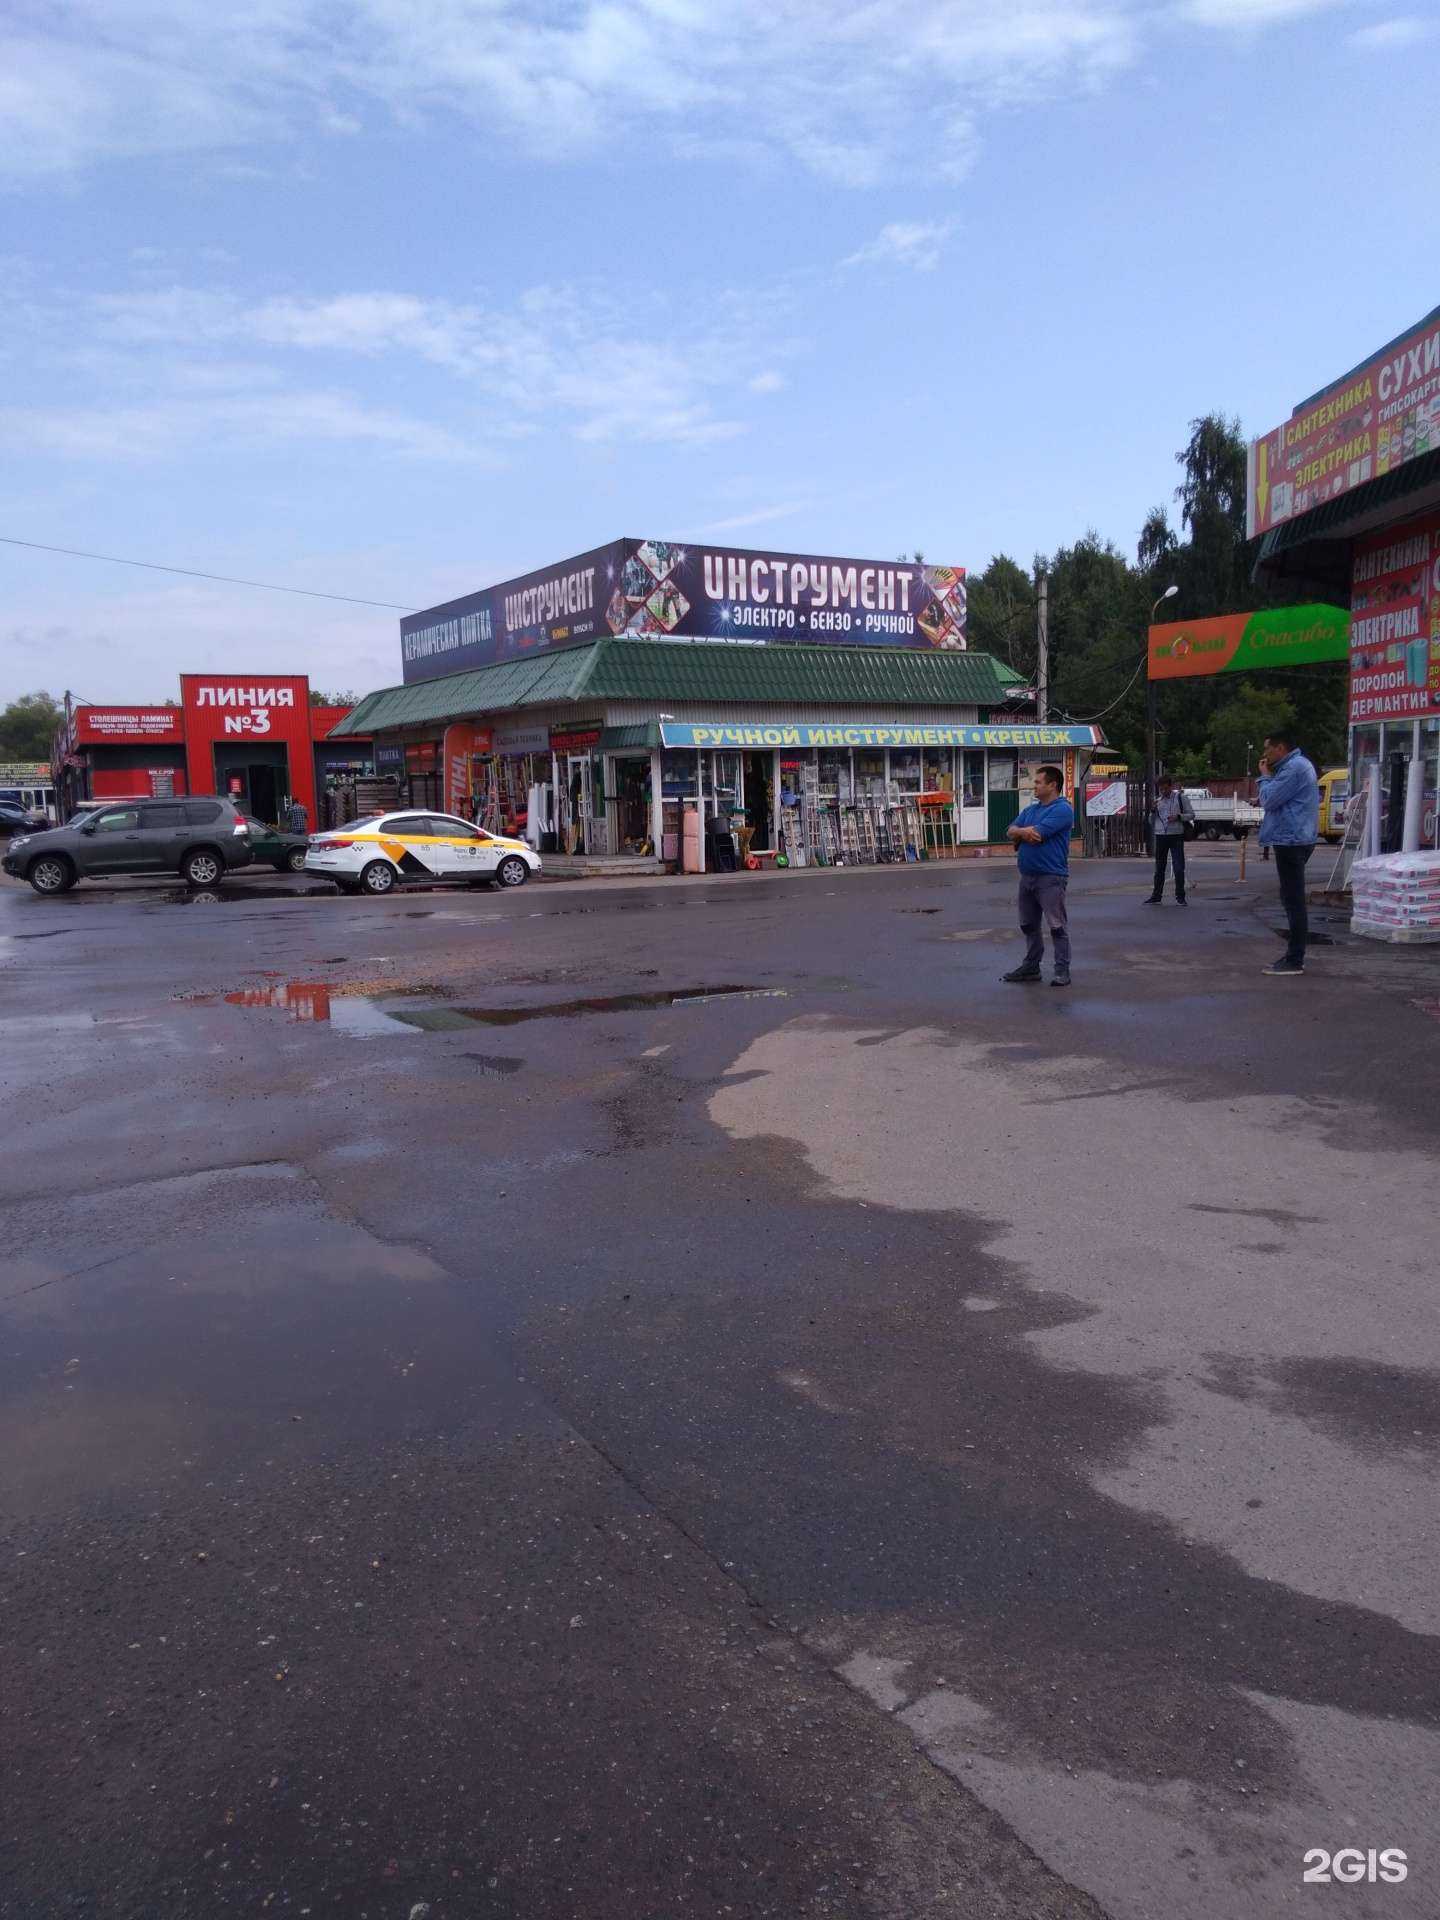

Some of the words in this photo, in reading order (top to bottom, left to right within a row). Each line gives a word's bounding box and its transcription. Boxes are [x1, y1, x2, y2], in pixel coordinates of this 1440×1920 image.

[1287, 378, 1372, 446] САНТЕХНИКА
[1296, 432, 1371, 489] ЭЛЕКТРИКА
[703, 555, 913, 612] ИНСТРУМЕНТ
[504, 567, 595, 632] ИНСТРУМЕНТ
[733, 605, 795, 629] ЭЛЕКТРО
[810, 611, 851, 632] БЕНЗО
[865, 612, 914, 635] РУЧНОЙ
[1250, 619, 1336, 650] Спасибо
[1351, 606, 1420, 648] ЭЛЕКТРИКА
[404, 618, 460, 662] КЕРАМИЧЕСКАЯ
[461, 609, 492, 646] ПЛИТКА
[196, 687, 294, 707] ЛИНИЯ
[1352, 670, 1405, 694] ПОРОЛОН
[89, 715, 139, 723] СТОЛЕШНИЦЫ
[141, 715, 174, 723] ЛАМИНАТ
[1351, 690, 1430, 719] ДЕРМАНТИН
[224, 709, 271, 734] №3
[692, 725, 800, 745] РУЧНОЙ
[808, 729, 967, 745] ИНСТРУМЕНТ
[984, 728, 1072, 745] КРЕПЁЖ
